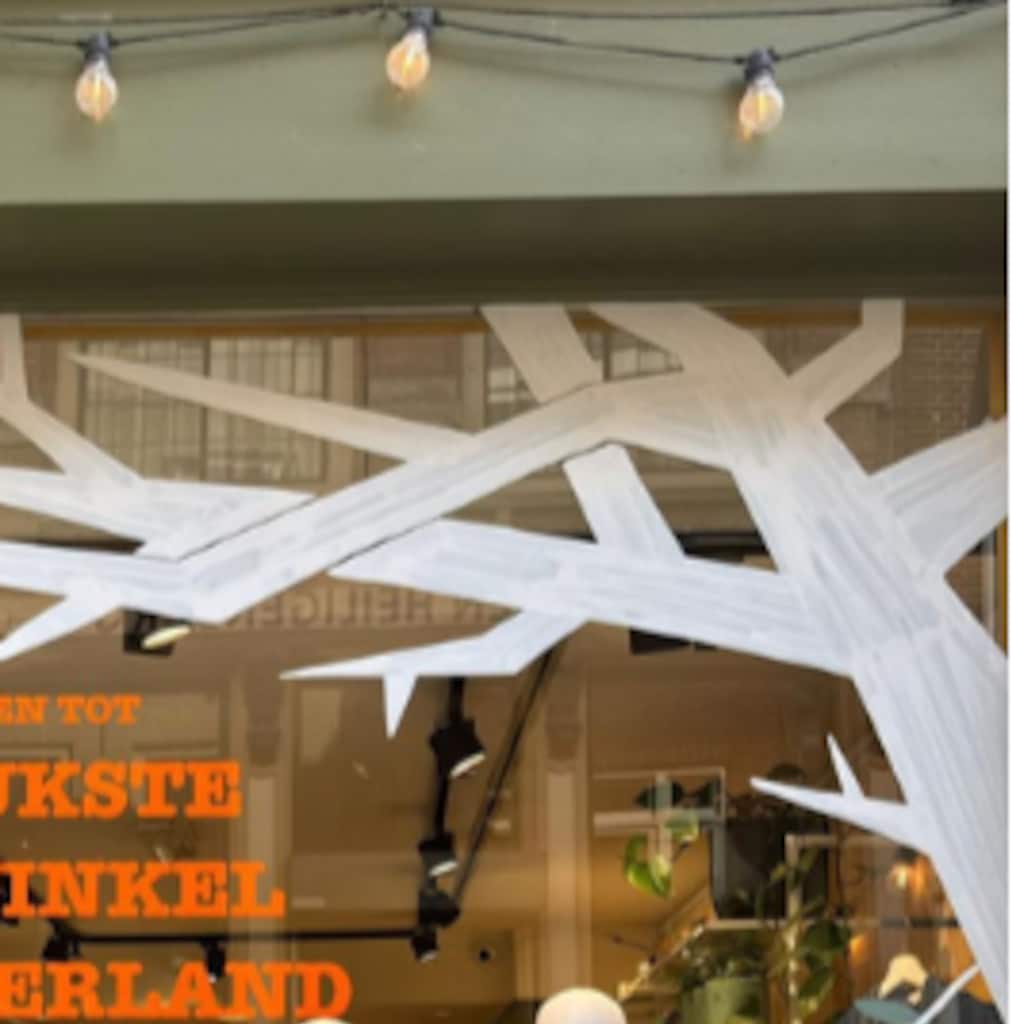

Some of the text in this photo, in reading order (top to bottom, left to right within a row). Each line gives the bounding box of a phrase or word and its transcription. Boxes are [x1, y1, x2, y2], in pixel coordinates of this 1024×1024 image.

[57, 695, 141, 724] TOT
[0, 860, 286, 918] INKEL
[0, 961, 353, 1019] ERLAND
